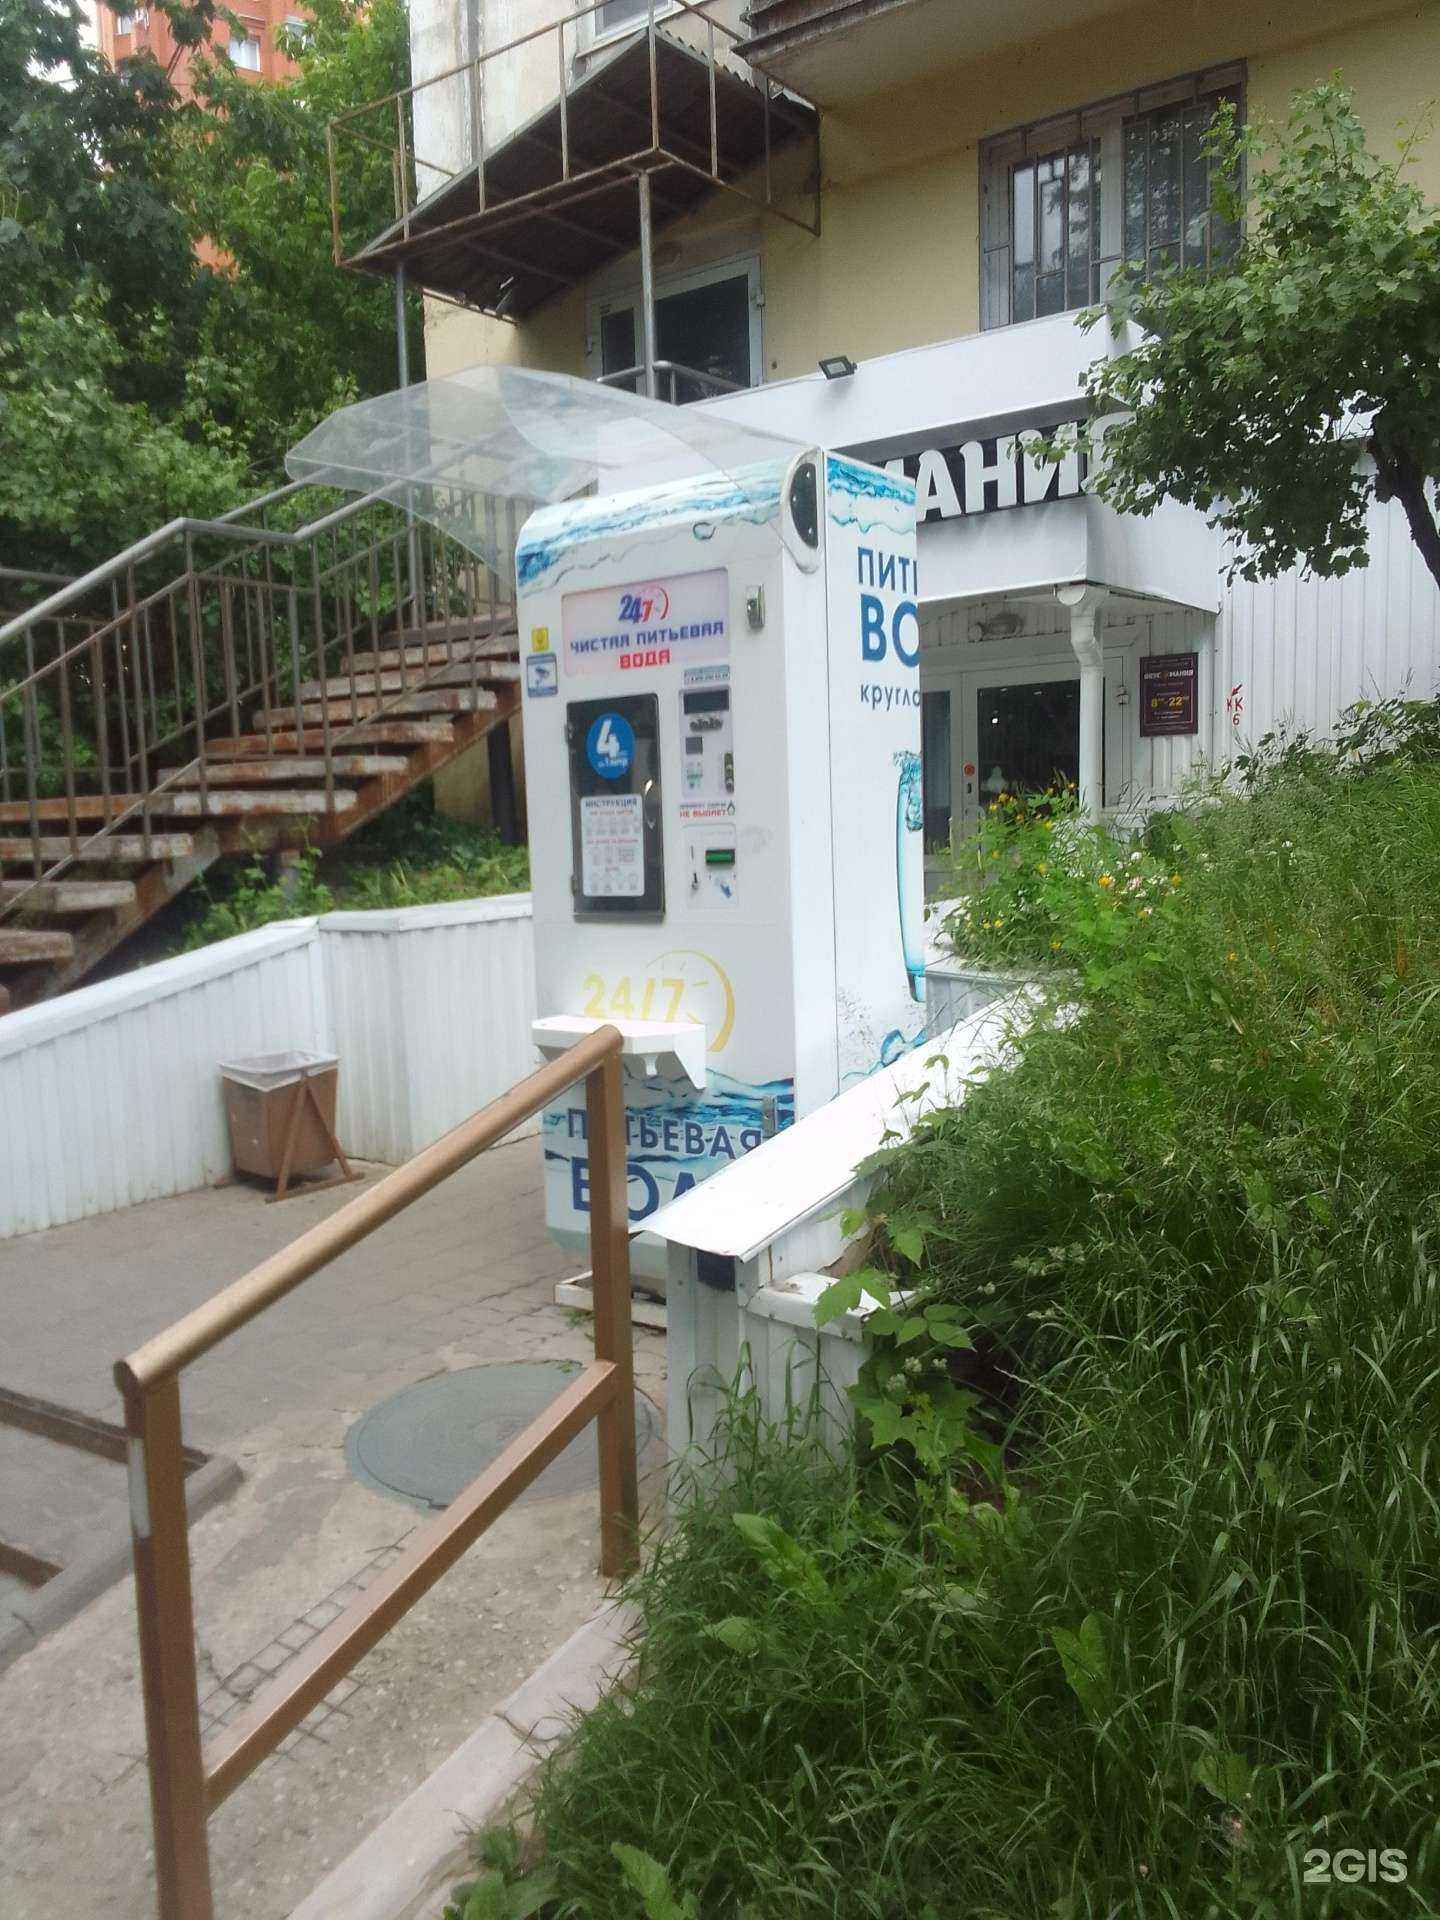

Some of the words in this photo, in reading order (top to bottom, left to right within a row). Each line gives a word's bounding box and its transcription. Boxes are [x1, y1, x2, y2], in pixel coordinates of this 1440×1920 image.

[886, 411, 1137, 522] АНИ
[570, 633, 629, 653] ЧИСТАЯ
[637, 621, 724, 645] ПИТЬЕВАЯ
[619, 648, 670, 669] ВОДА
[597, 719, 620, 758] 4
[583, 973, 686, 1023] 24/7
[568, 1107, 762, 1160] ПТЬЕВАЯ
